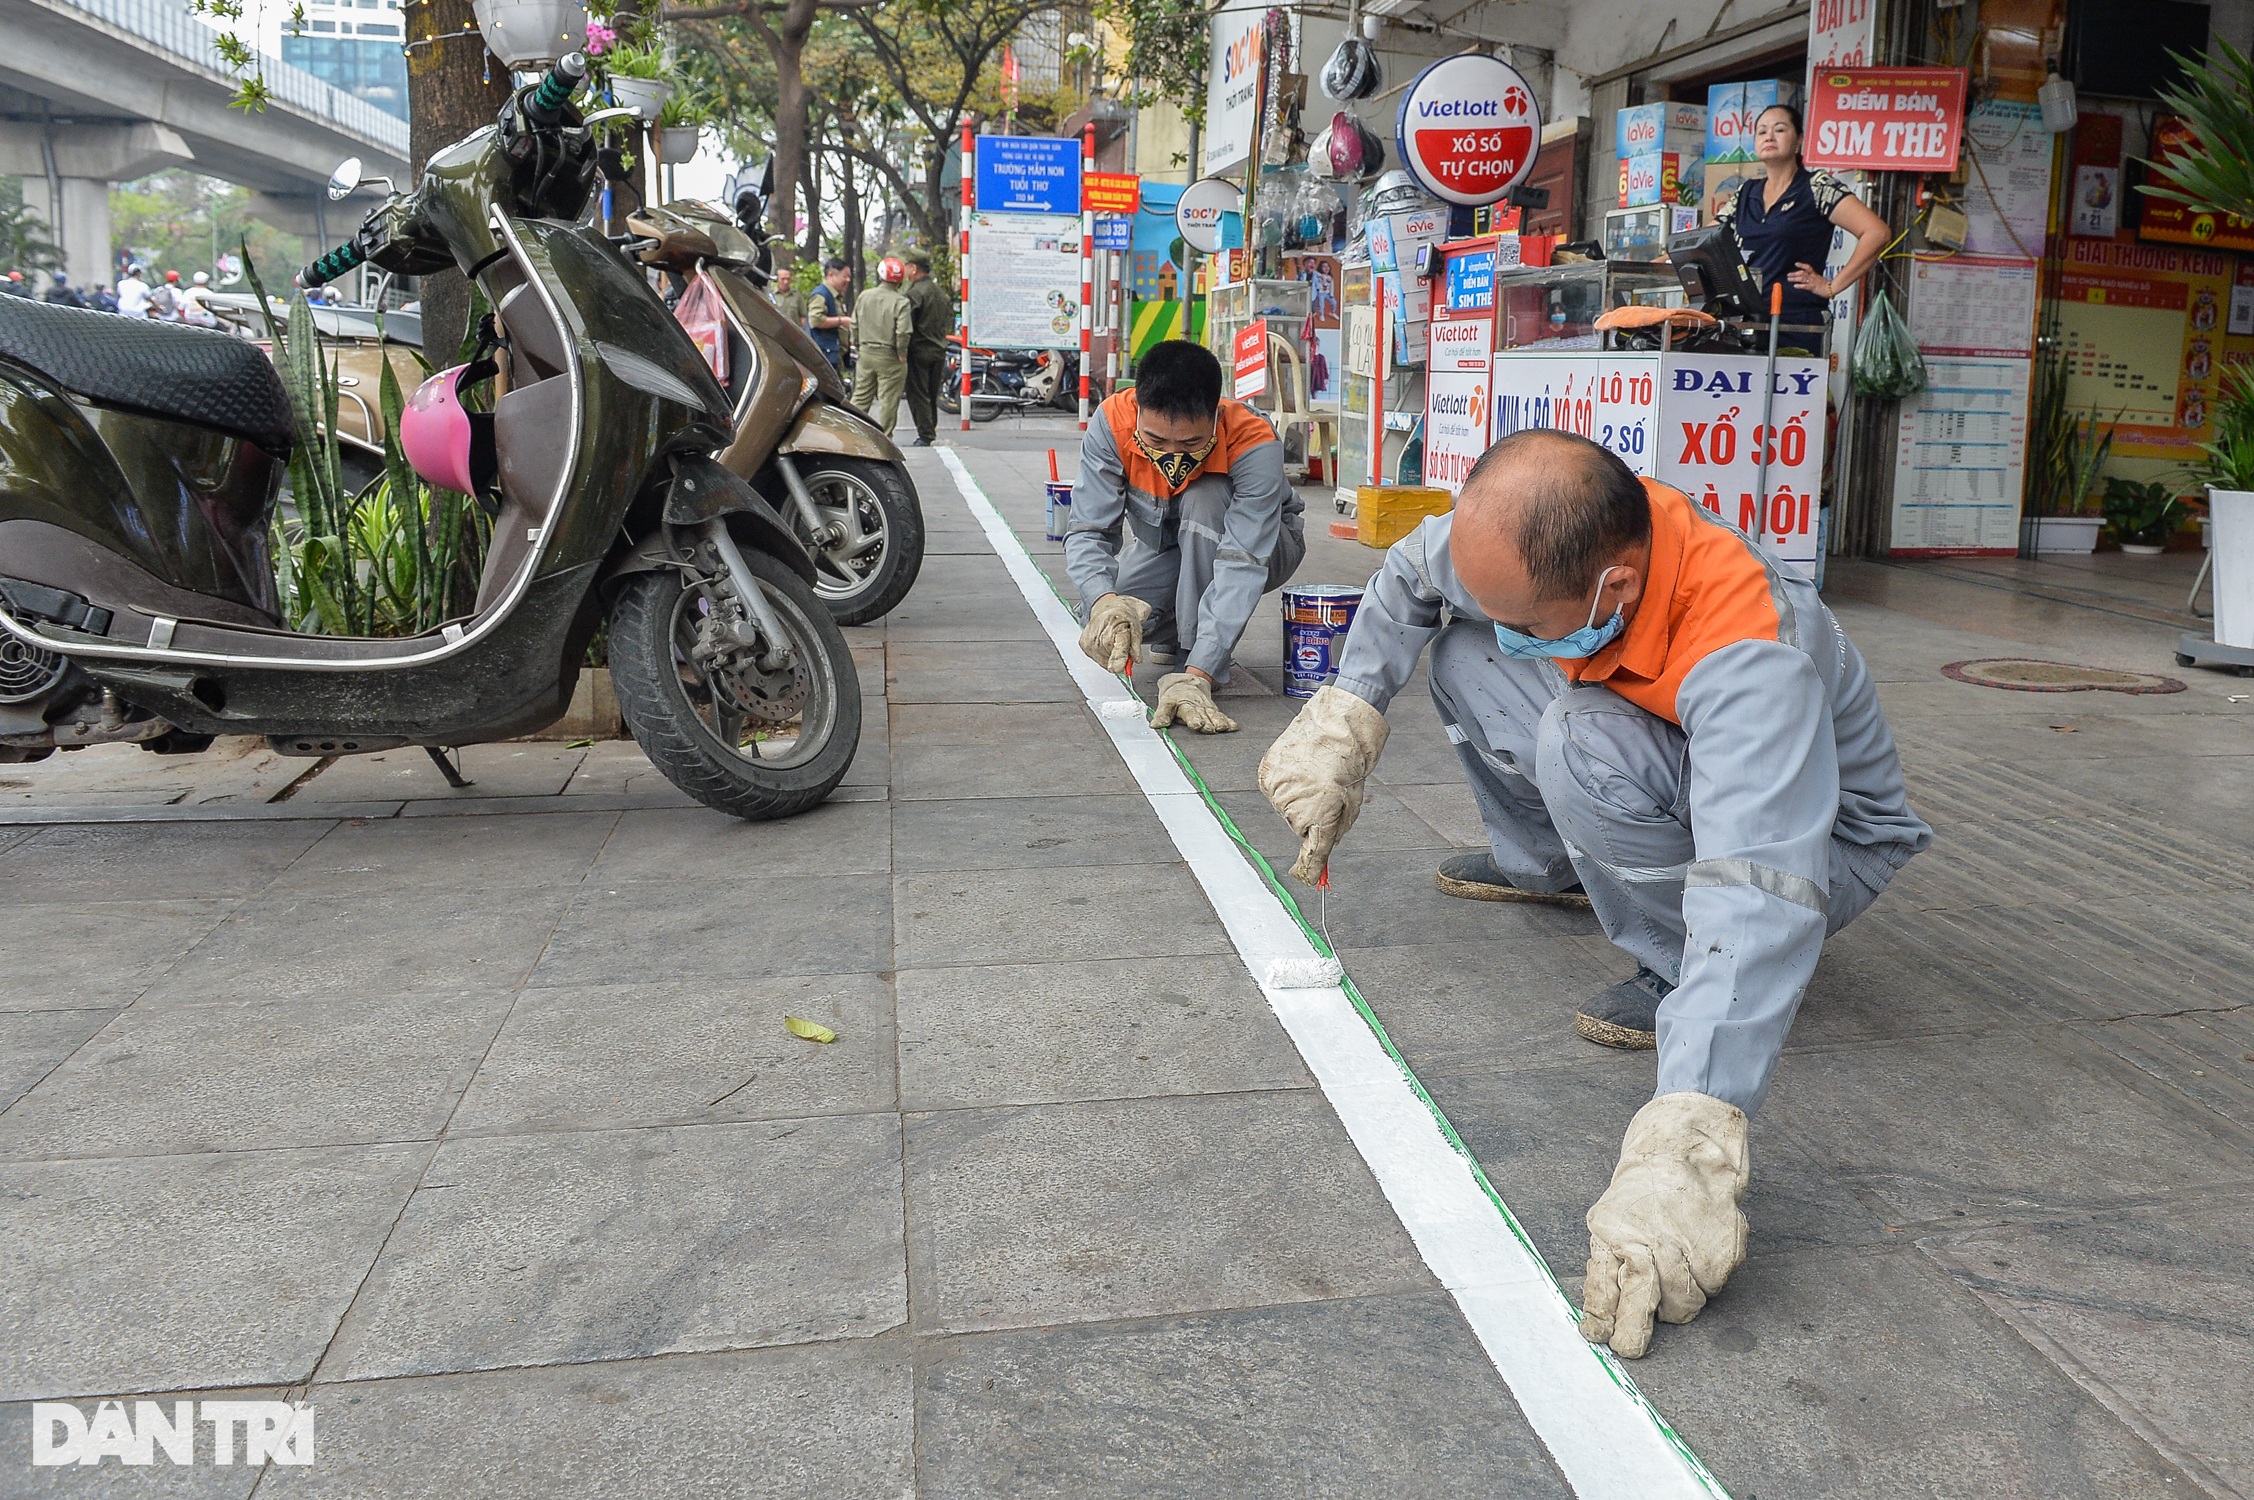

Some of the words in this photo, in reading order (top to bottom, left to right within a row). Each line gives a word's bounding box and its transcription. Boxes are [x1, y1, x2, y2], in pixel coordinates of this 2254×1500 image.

[1419, 100, 1498, 118] Vietlott
[1837, 87, 1889, 111] ĐIỂM
[1894, 91, 1938, 112] BÁN
[1675, 113, 1699, 125] laVie
[1714, 111, 1755, 137] laVi
[1452, 131, 1477, 153] XỔ
[1479, 131, 1502, 152] SỐ
[1627, 121, 1655, 143] laVie
[1816, 120, 1876, 157] SIM
[1883, 108, 1948, 158] THẺ
[1047, 166, 1065, 176] NON
[1440, 159, 1466, 180] TỰ
[1467, 159, 1514, 179] CHỌN
[1629, 170, 1654, 190] laVie
[1662, 168, 1676, 189] 6
[1619, 174, 1628, 194] 6
[1406, 220, 1434, 234] laVie
[1371, 235, 1389, 255] laVie
[1230, 259, 1242, 275] 6
[2181, 252, 2225, 277] KENO
[1383, 289, 1399, 309] aVie
[1458, 293, 1474, 308] SIM
[1476, 288, 1493, 306] THẺ
[1241, 332, 1260, 351] viettel
[1434, 324, 1478, 342] Vietlott
[1600, 370, 1623, 404] LÔ
[1628, 371, 1653, 406] TÔ
[1672, 368, 1752, 399] ĐẠI
[1765, 367, 1820, 396] LÝ
[1432, 393, 1468, 415] Vietlott
[1602, 424, 1613, 450] 2
[1619, 417, 1647, 455] SỐ
[1679, 406, 1740, 466] XỔ
[1751, 410, 1810, 467] SỐ
[1738, 484, 1811, 545] NỘI
